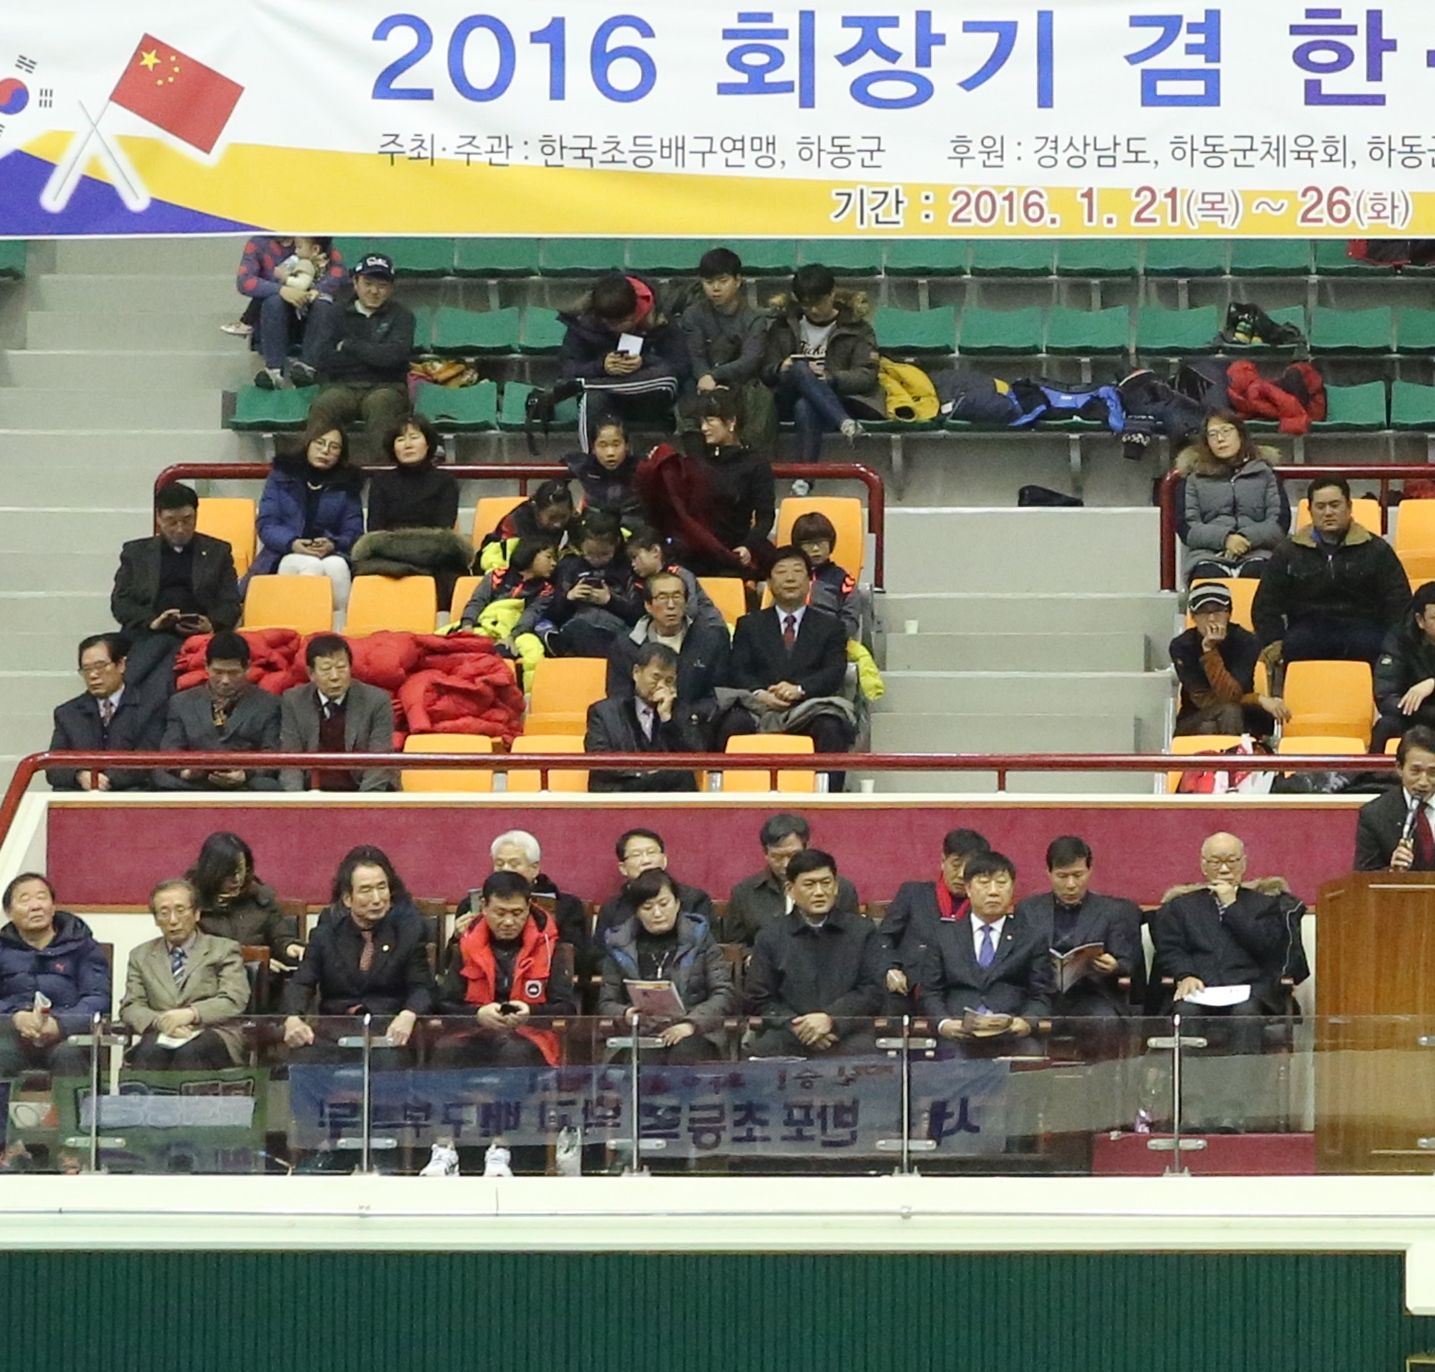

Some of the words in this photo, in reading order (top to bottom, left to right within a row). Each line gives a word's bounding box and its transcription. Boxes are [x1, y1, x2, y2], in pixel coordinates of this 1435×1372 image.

[370, 13, 658, 103] 2016
[715, 8, 1055, 110] 회장기
[1123, 8, 1222, 108] 겸
[537, 133, 787, 170] 한국초등배구연맹,
[795, 134, 887, 169] 하동군
[945, 134, 1006, 169] 후원
[1032, 134, 1160, 170] 경상남도,
[1169, 134, 1358, 170] 하동군체육회,
[831, 187, 906, 227] 기간
[950, 188, 1060, 227] 2016.
[1077, 188, 1115, 227] 1.
[1131, 186, 1244, 229] 21(목)
[1297, 185, 1414, 229] 26(화)
